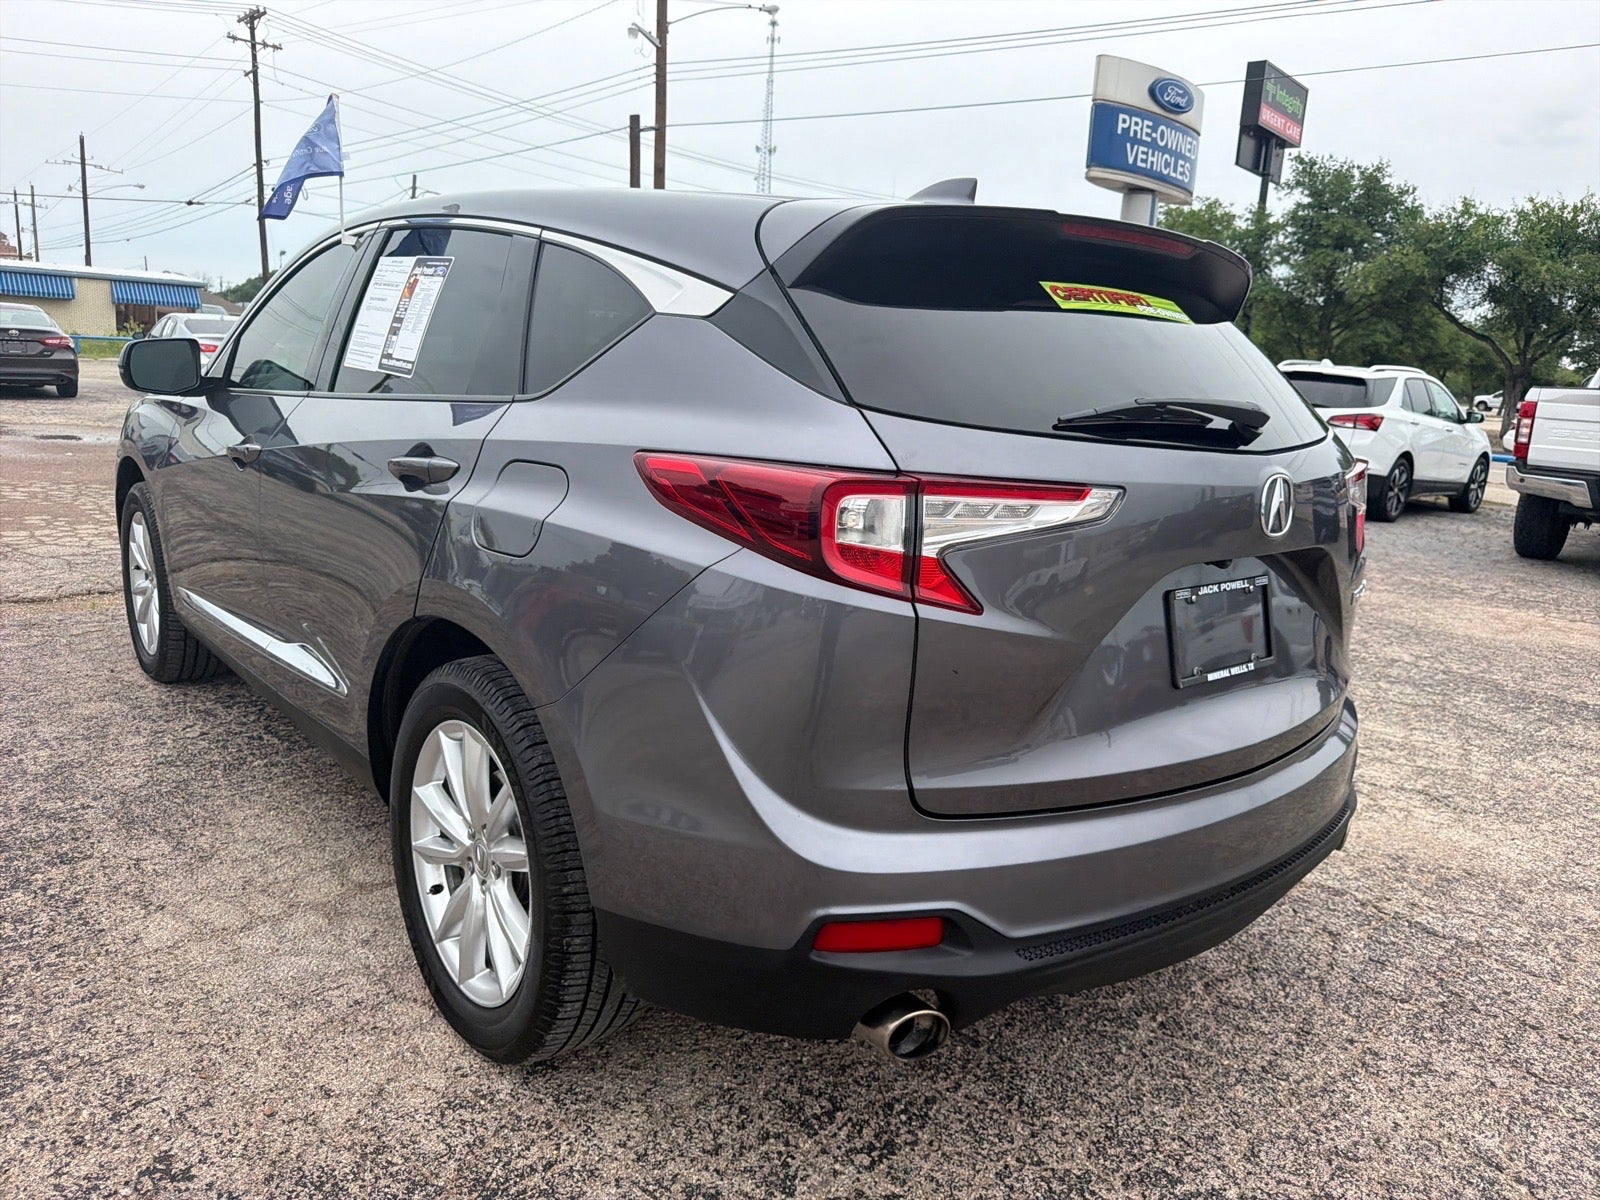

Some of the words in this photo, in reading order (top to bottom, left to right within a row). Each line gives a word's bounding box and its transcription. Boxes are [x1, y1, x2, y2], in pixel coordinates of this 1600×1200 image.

[1163, 85, 1188, 108] Ford
[1276, 84, 1302, 119] Integrity
[1116, 113, 1198, 160] PRE-OWNED
[1262, 108, 1285, 130] URGENT
[1286, 121, 1301, 140] CARE
[1126, 142, 1192, 183] VEHICLES
[1049, 284, 1153, 308] CERTIFIED
[1198, 585, 1219, 596] JACK
[1220, 580, 1250, 592] POWELL
[1207, 668, 1230, 682] MINERAL
[1247, 662, 1255, 671] TX
